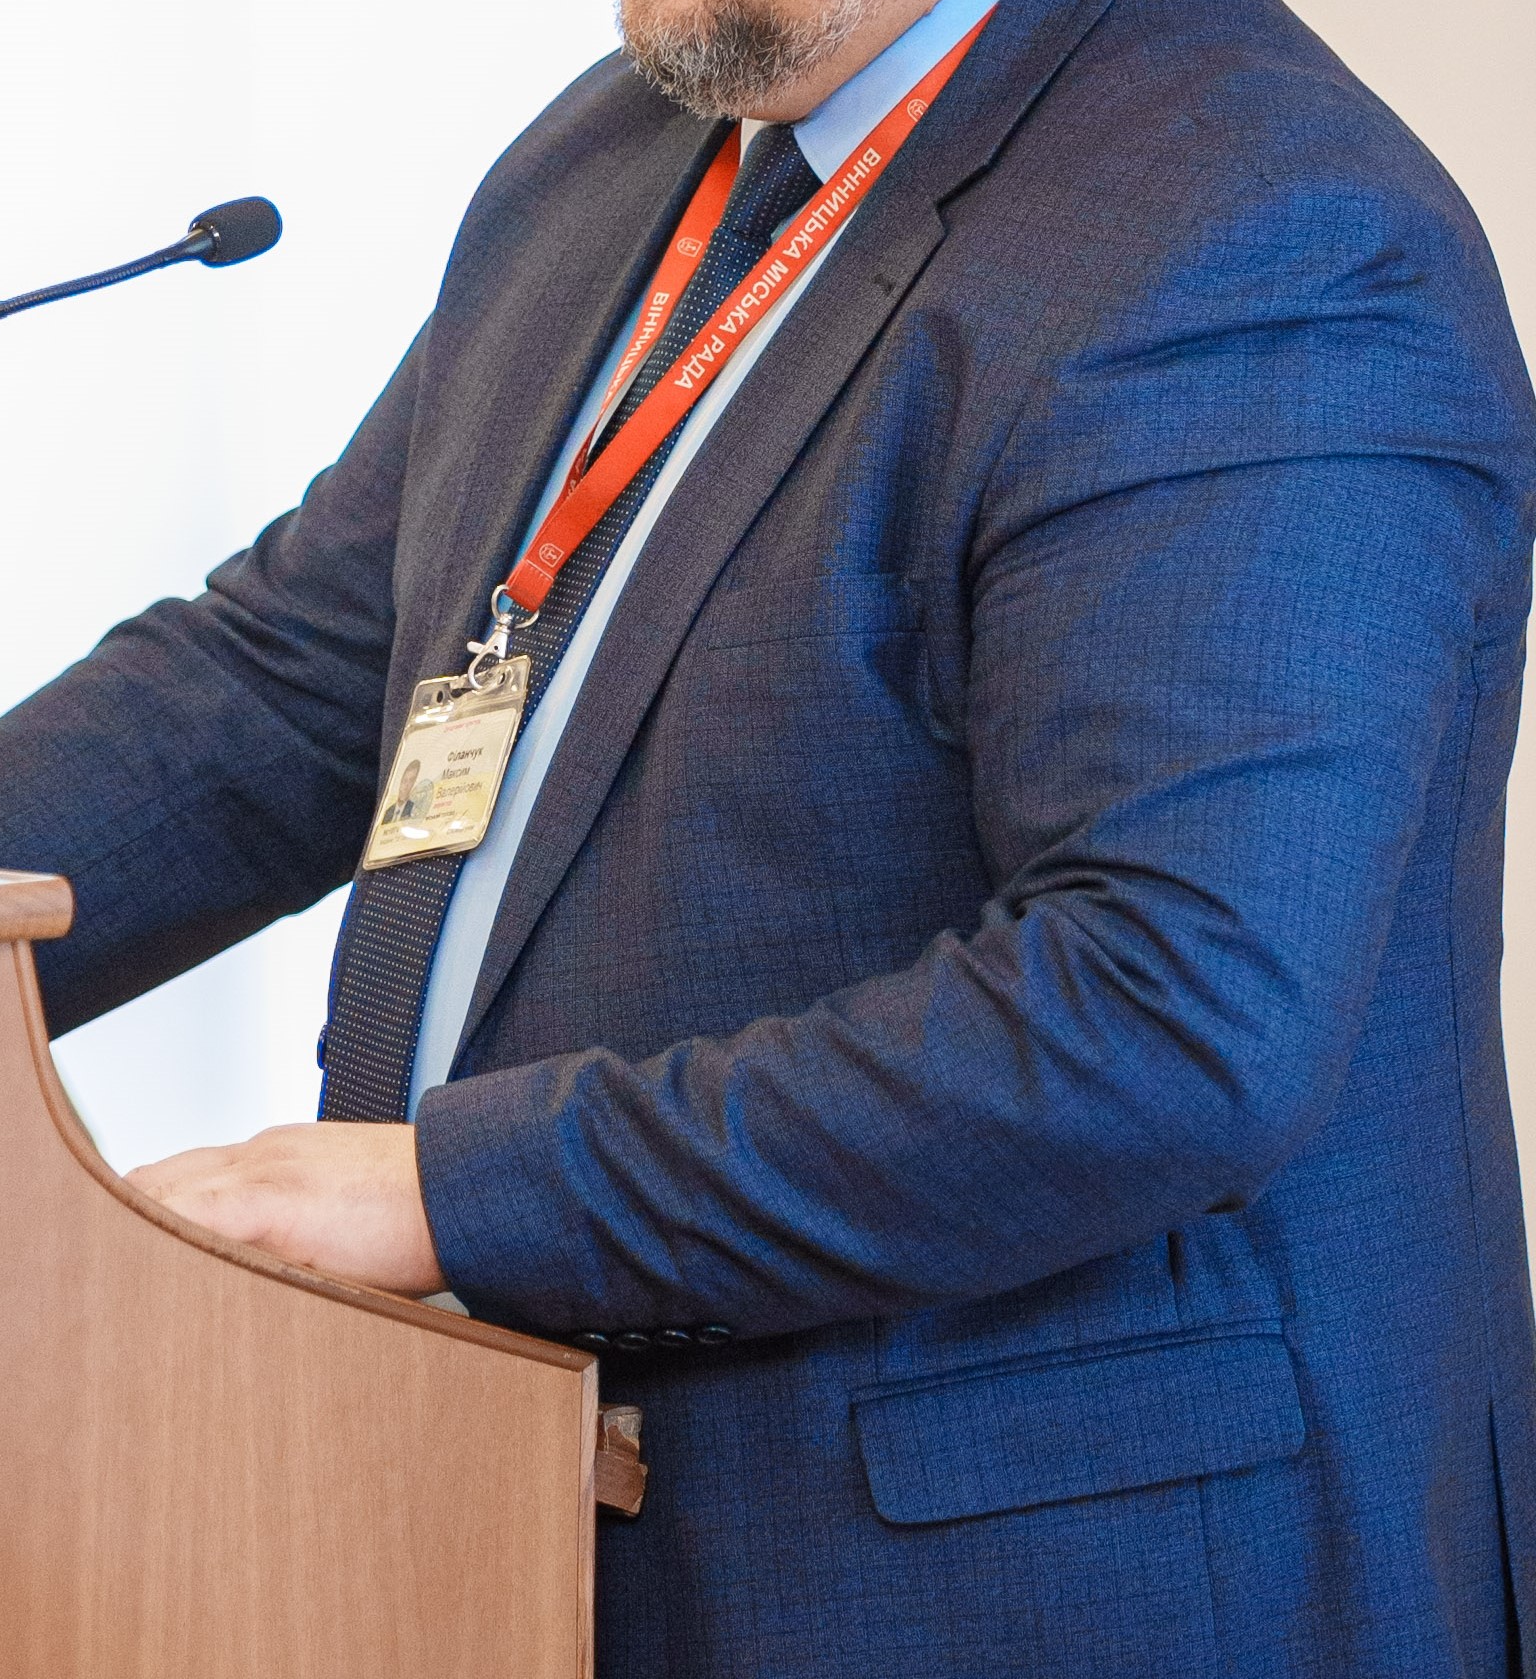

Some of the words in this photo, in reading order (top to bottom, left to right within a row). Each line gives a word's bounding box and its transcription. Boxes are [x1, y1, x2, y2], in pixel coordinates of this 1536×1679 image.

[783, 147, 881, 260] ВІННИЦЬКА
[719, 259, 789, 334] МІСЬКА
[674, 334, 725, 389] РАДА
